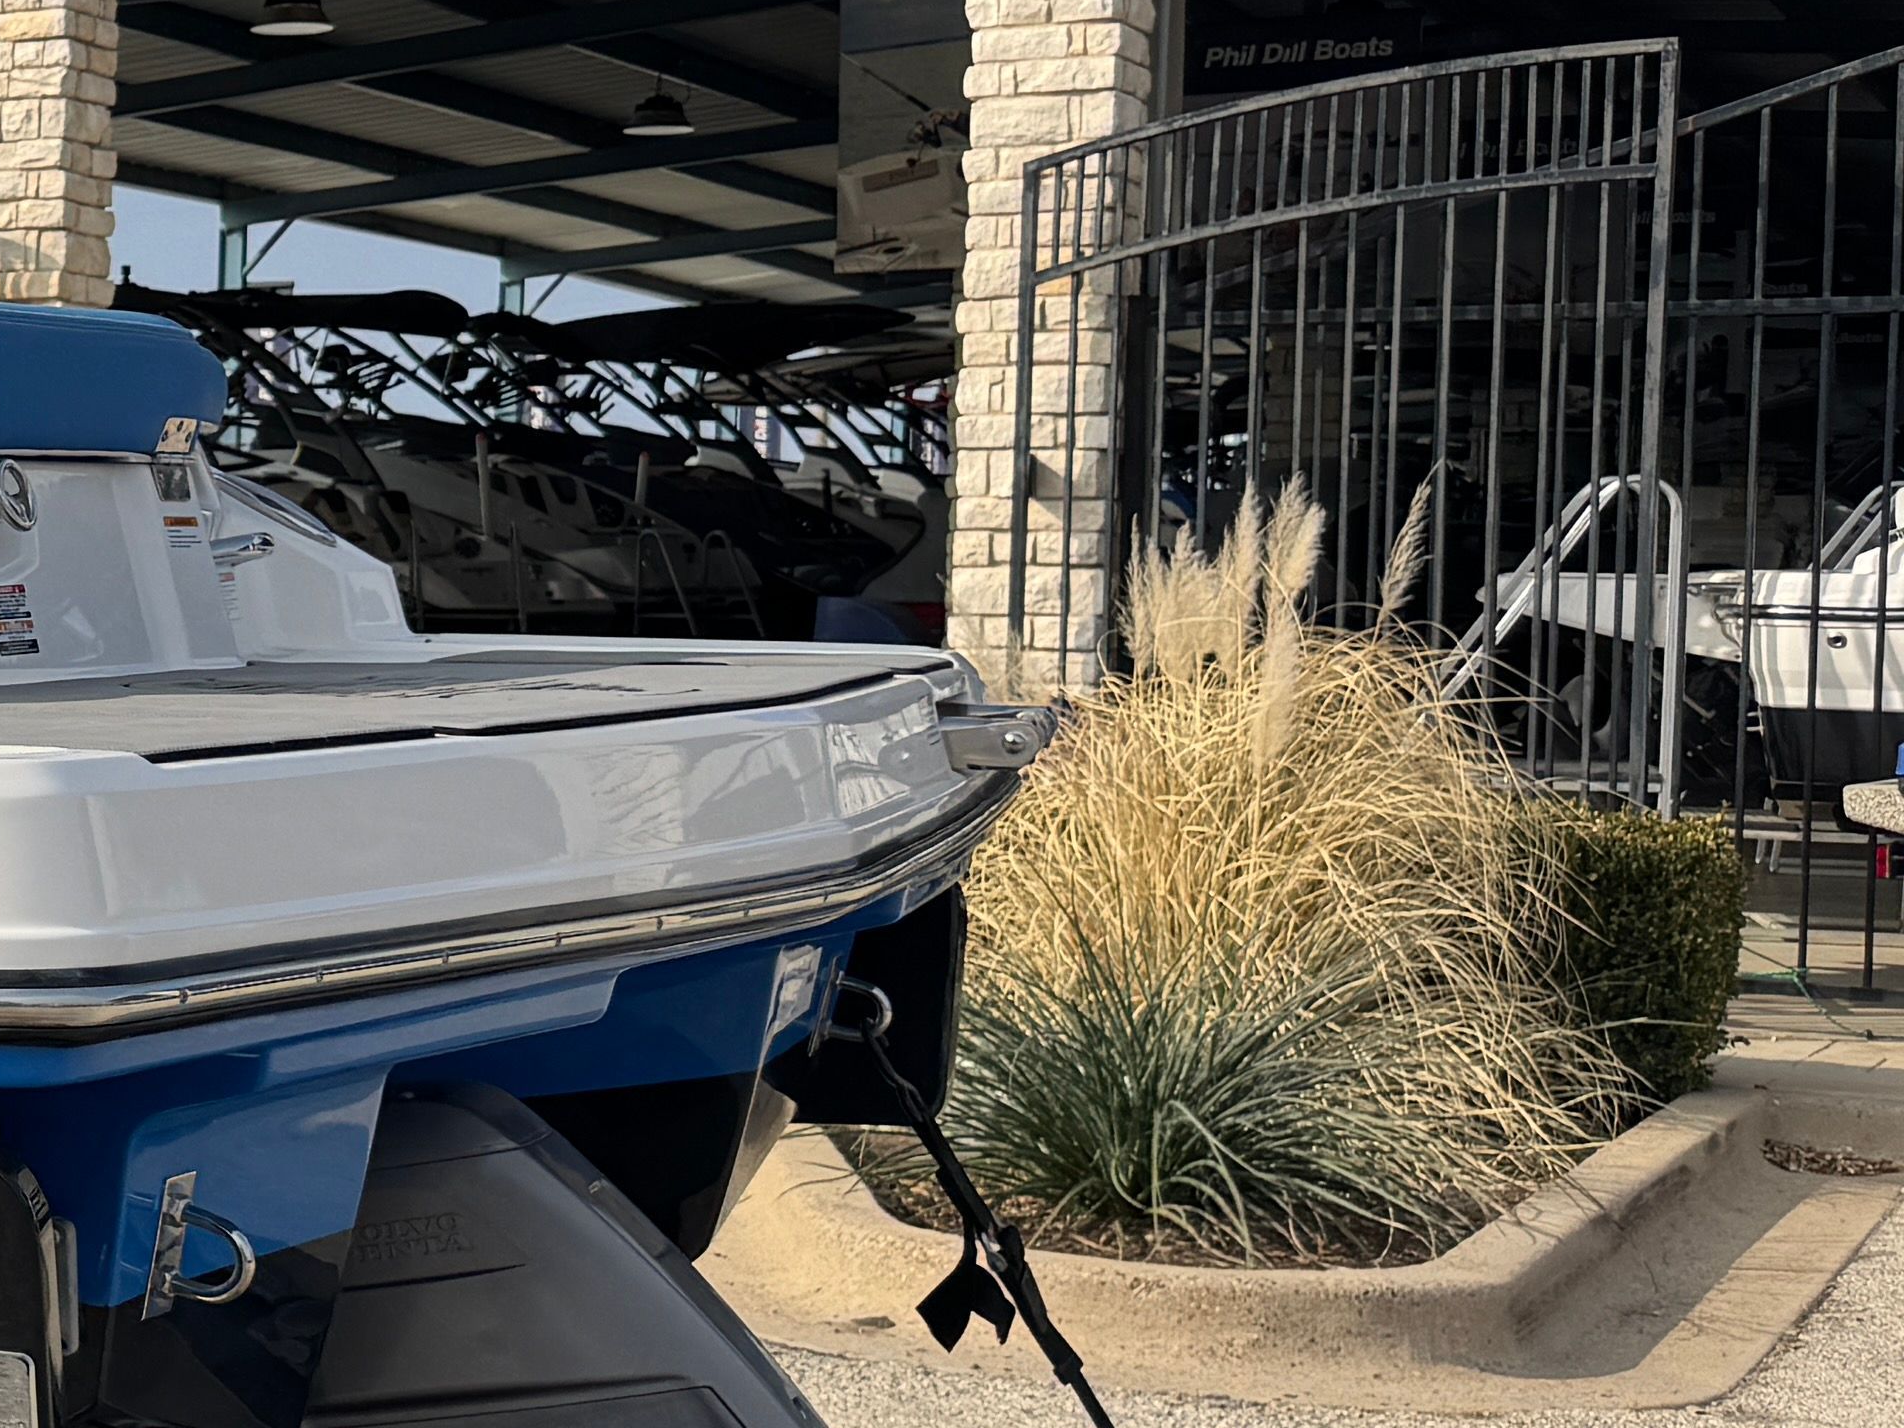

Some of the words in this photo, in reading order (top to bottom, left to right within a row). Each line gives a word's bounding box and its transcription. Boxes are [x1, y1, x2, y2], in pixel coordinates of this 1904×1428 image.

[1204, 44, 1256, 69] Phil
[1261, 40, 1308, 65] Dill
[1313, 36, 1394, 61] Boats
[354, 1210, 464, 1242] OLVO
[356, 1232, 475, 1263] ENTA
